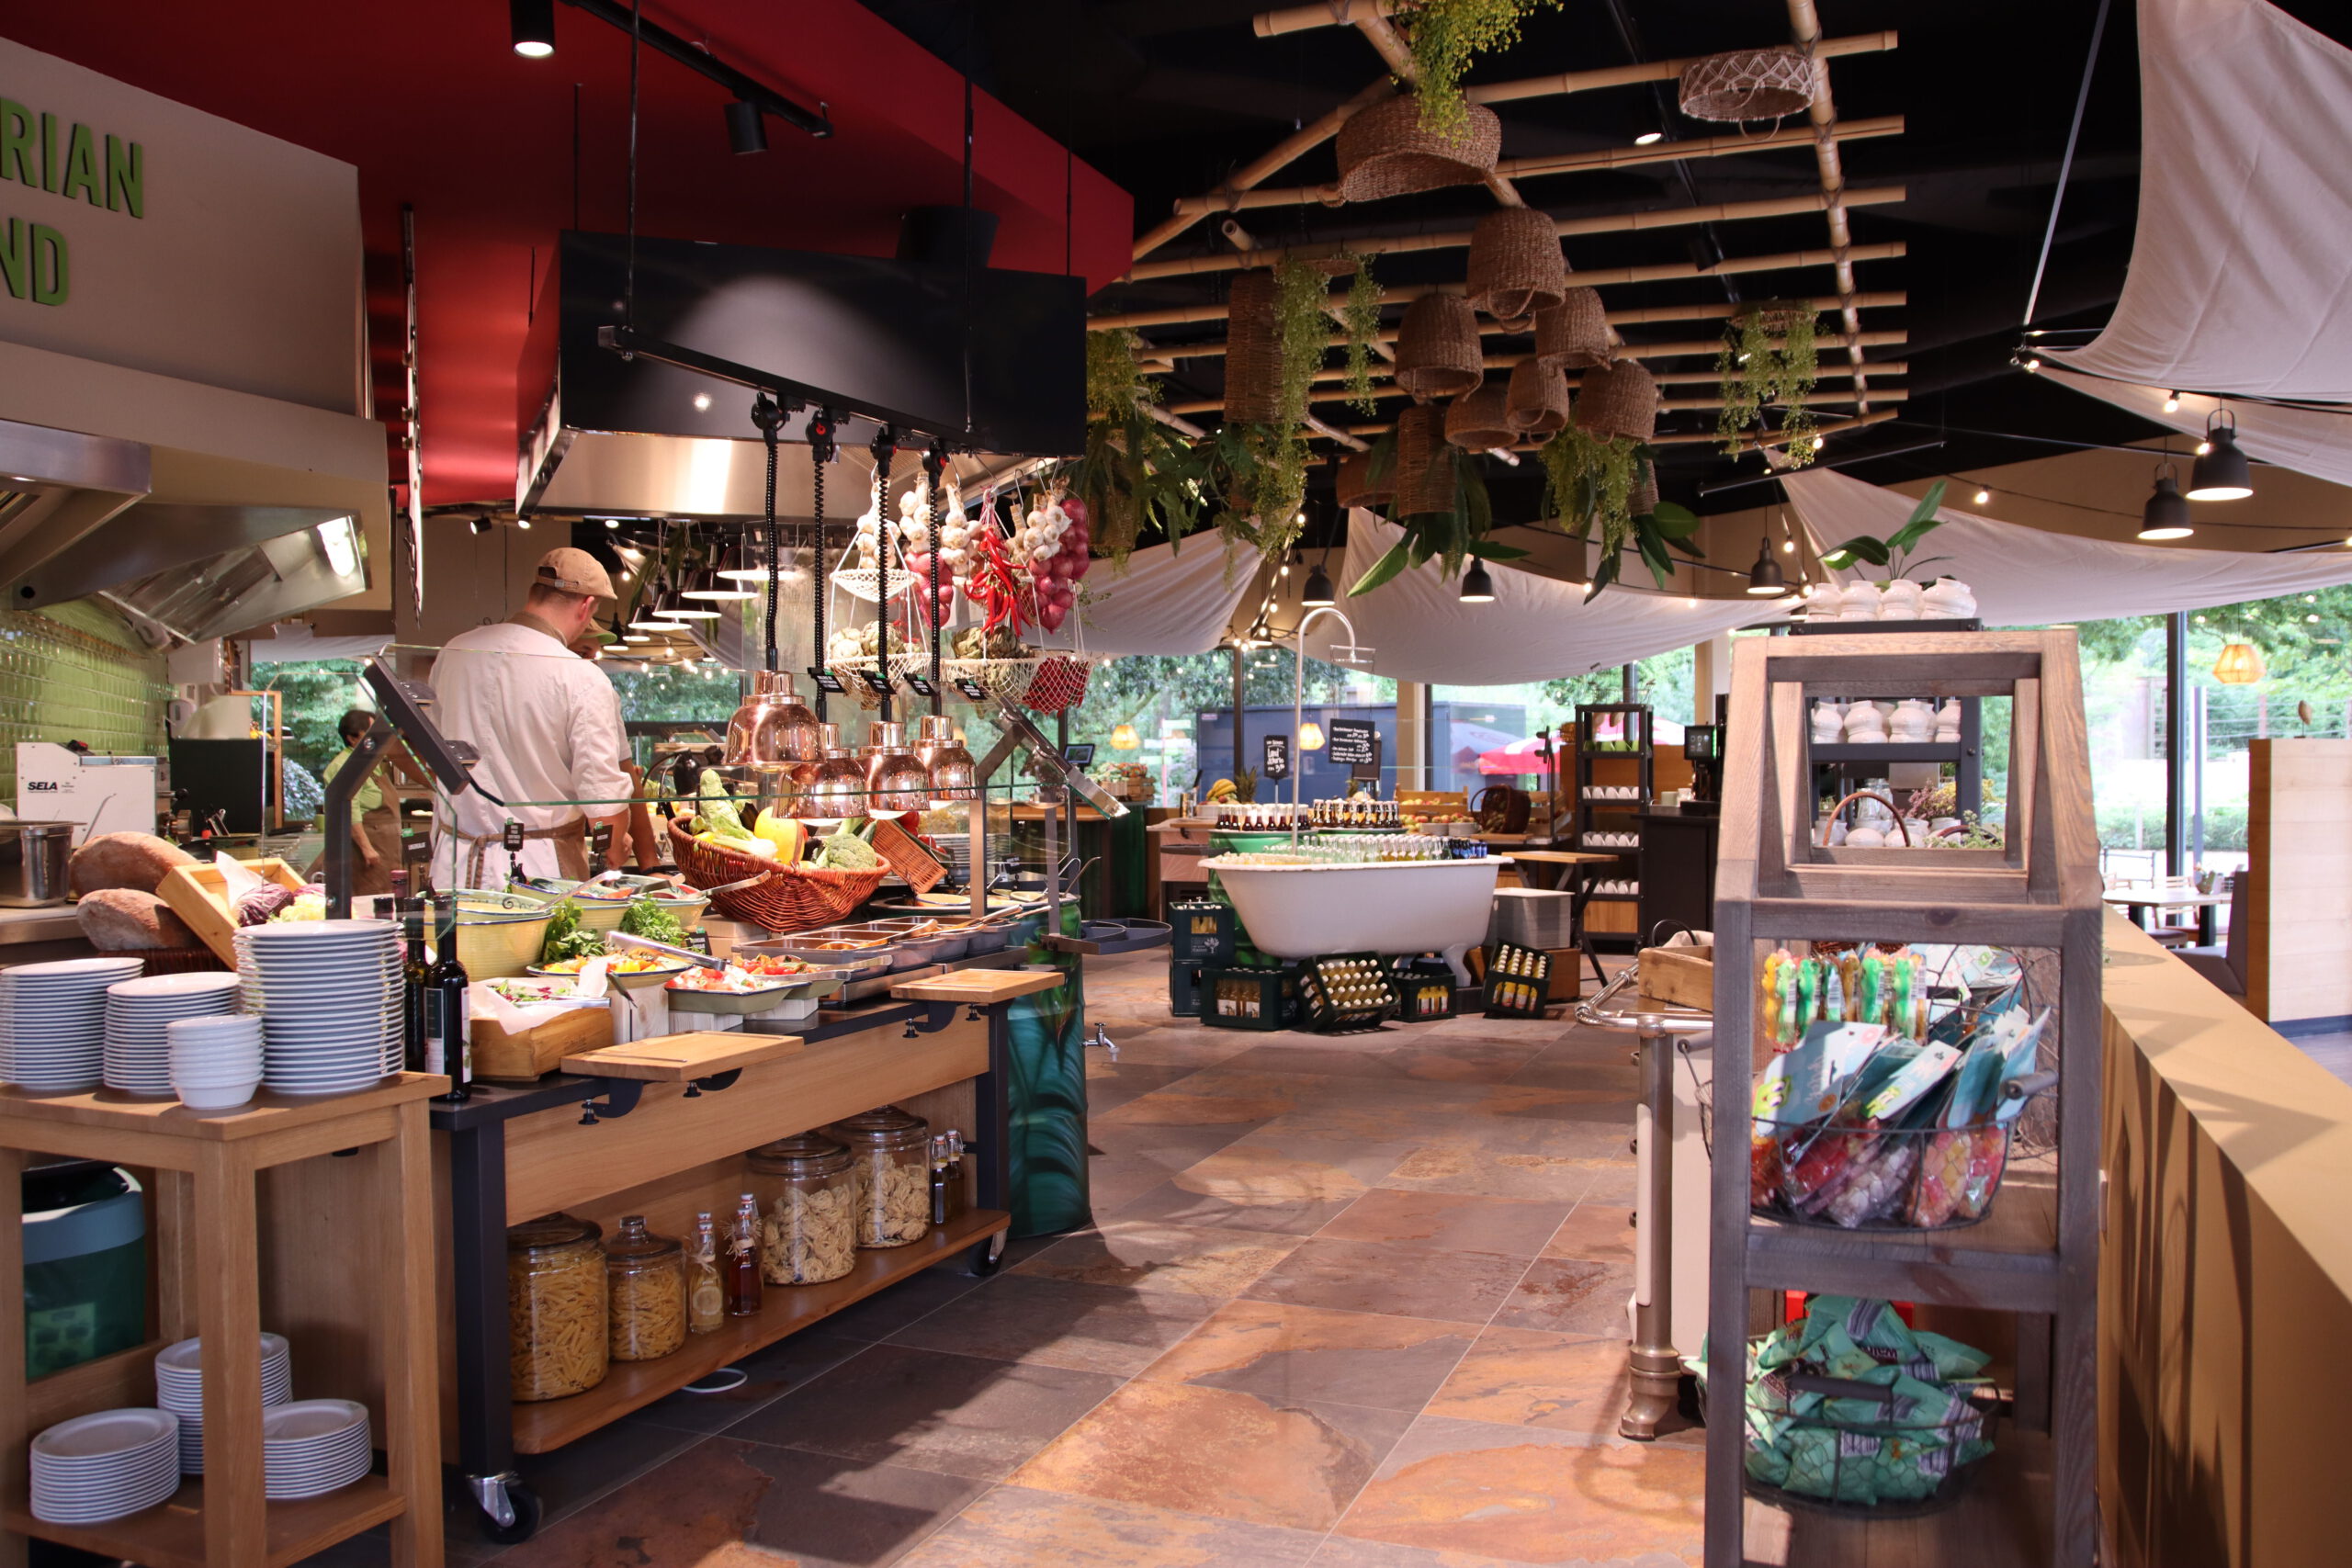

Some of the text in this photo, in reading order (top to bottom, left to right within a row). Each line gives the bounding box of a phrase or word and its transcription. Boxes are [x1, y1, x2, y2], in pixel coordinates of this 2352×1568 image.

[0, 96, 143, 220] RIAN
[0, 217, 69, 307] ND
[28, 782, 58, 791] SELA
